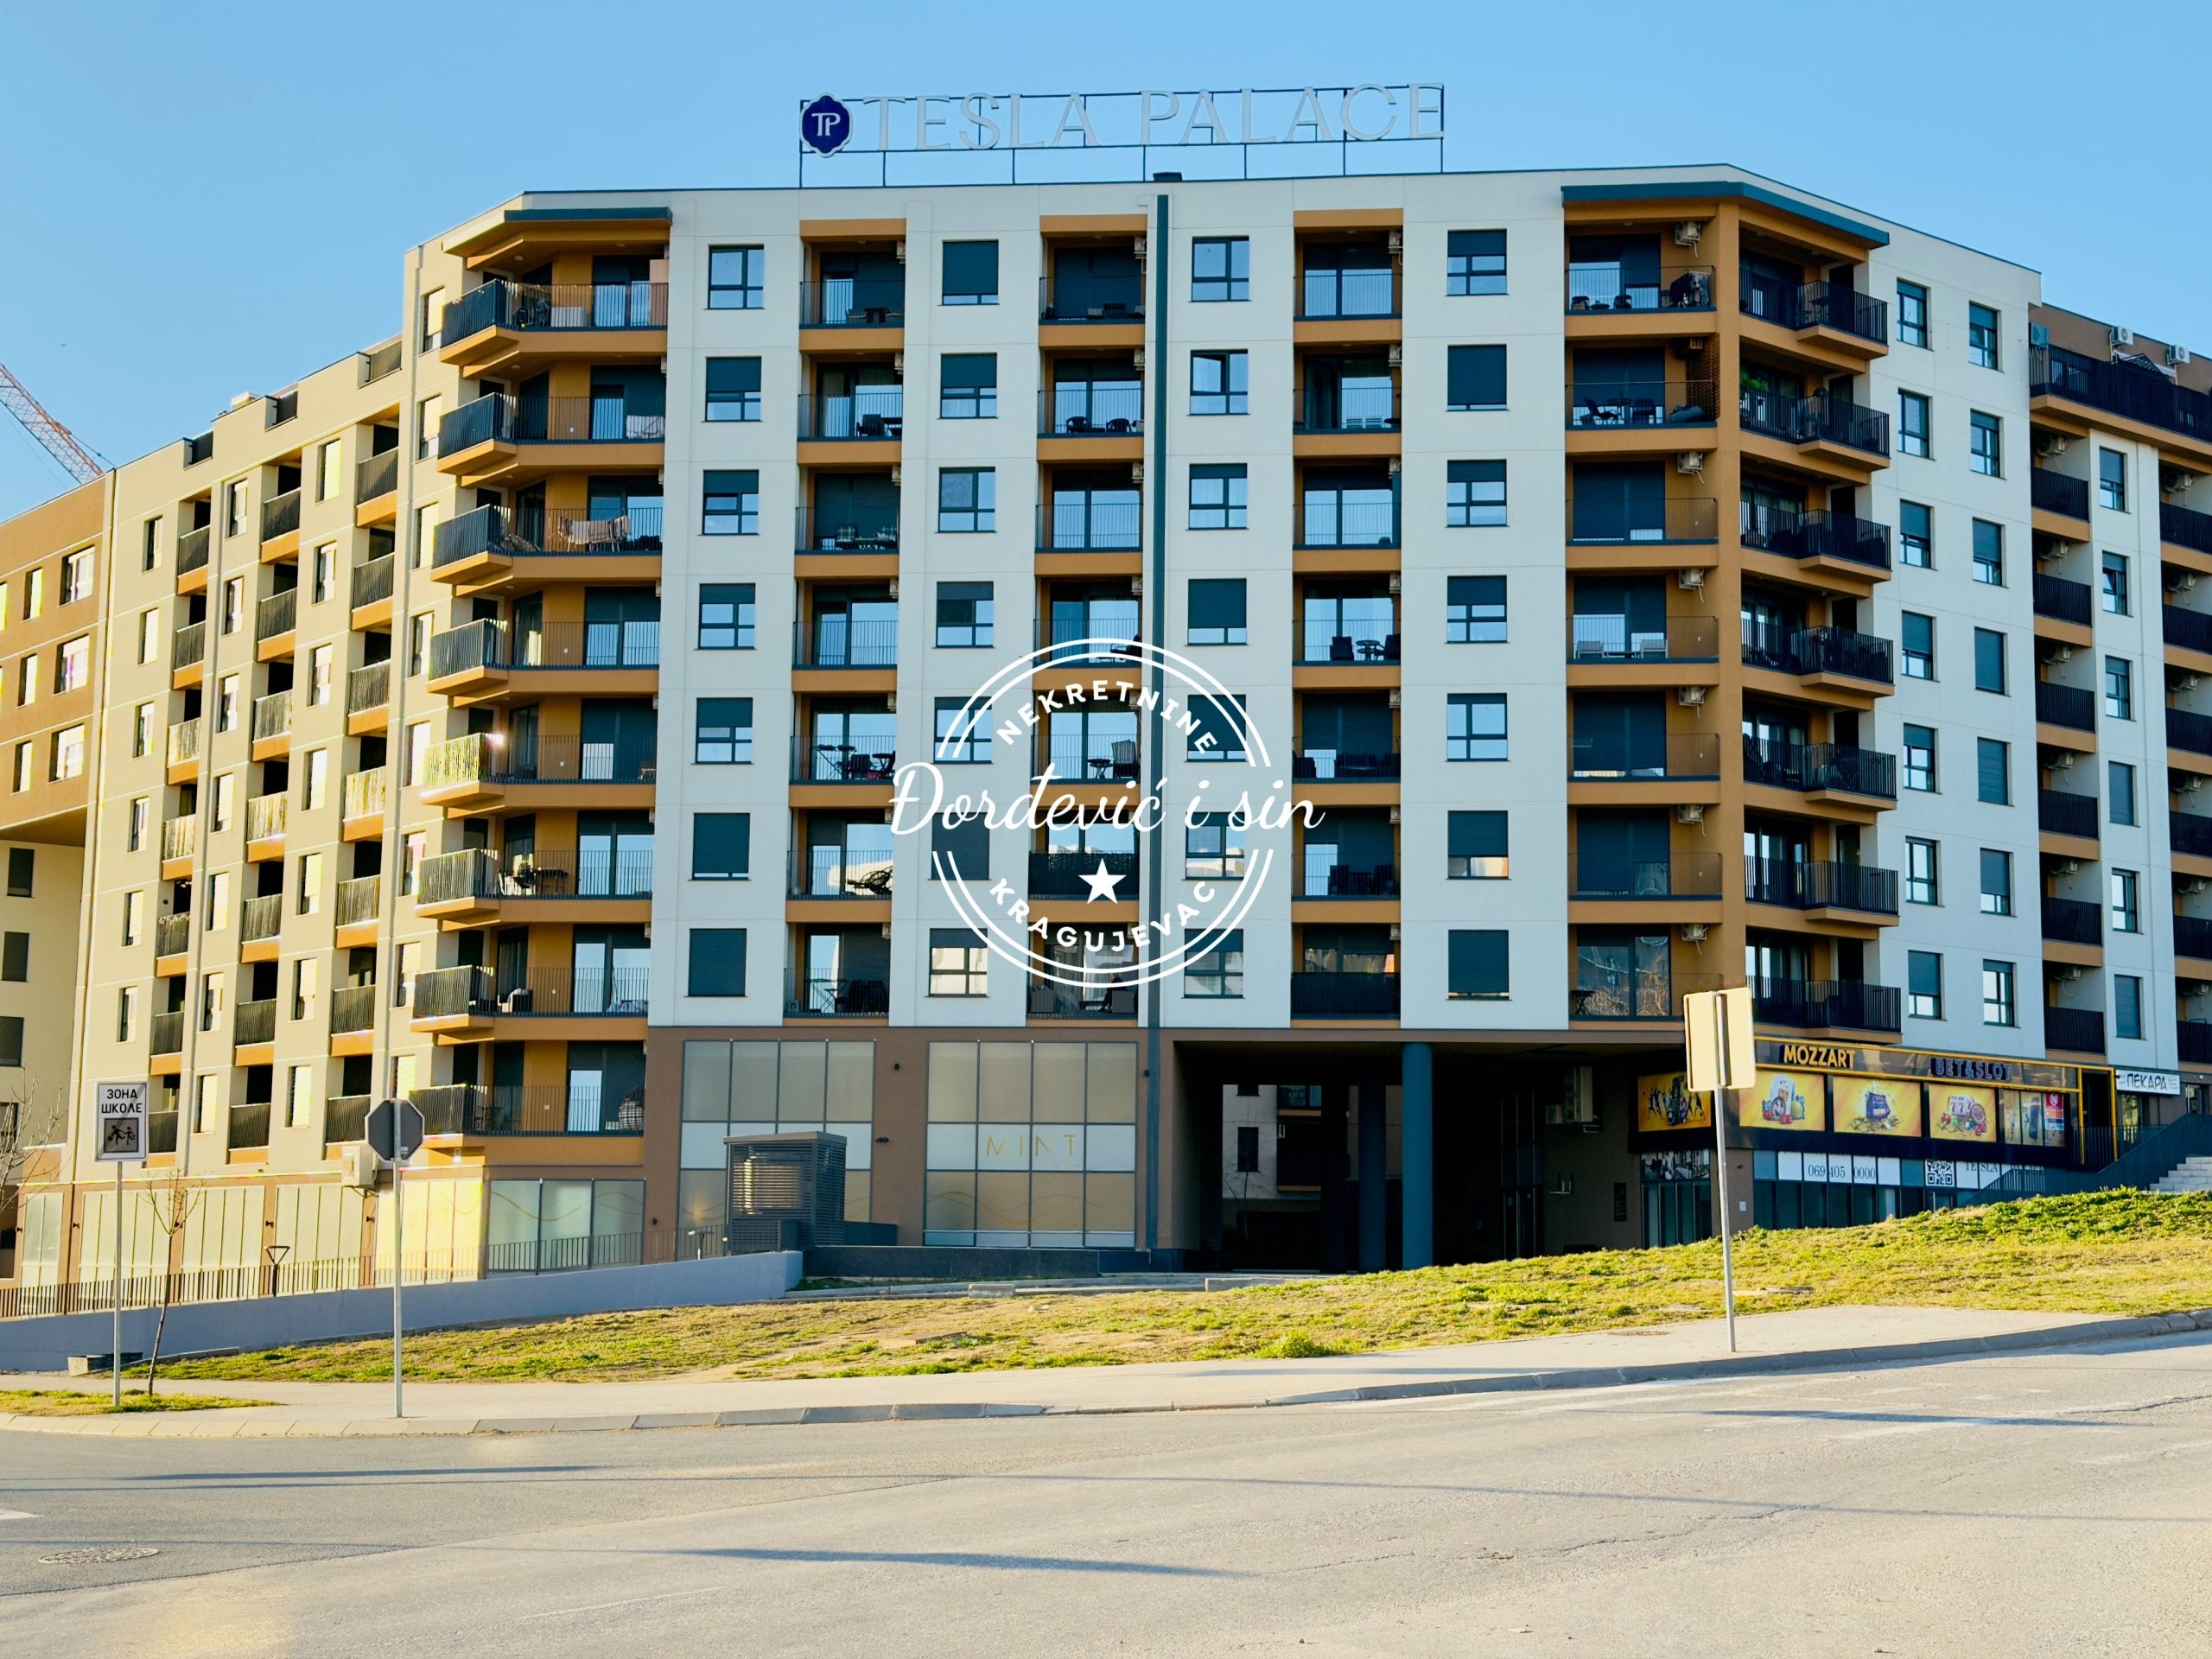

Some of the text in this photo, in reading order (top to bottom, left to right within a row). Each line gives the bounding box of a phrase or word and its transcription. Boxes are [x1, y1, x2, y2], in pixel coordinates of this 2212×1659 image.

[864, 83, 1444, 151] TESLA PALACE
[1783, 1044, 2012, 1081] MOZZART BET&SLOT
[2126, 1073, 2167, 1090] ПЕКАРА
[106, 1089, 138, 1099] ЗОНА
[101, 1103, 143, 1114] ШКОЛЕ
[986, 1134, 1077, 1157] MINT
[1808, 1164, 1826, 1177] 069
[1853, 1166, 1876, 1179] 0000
